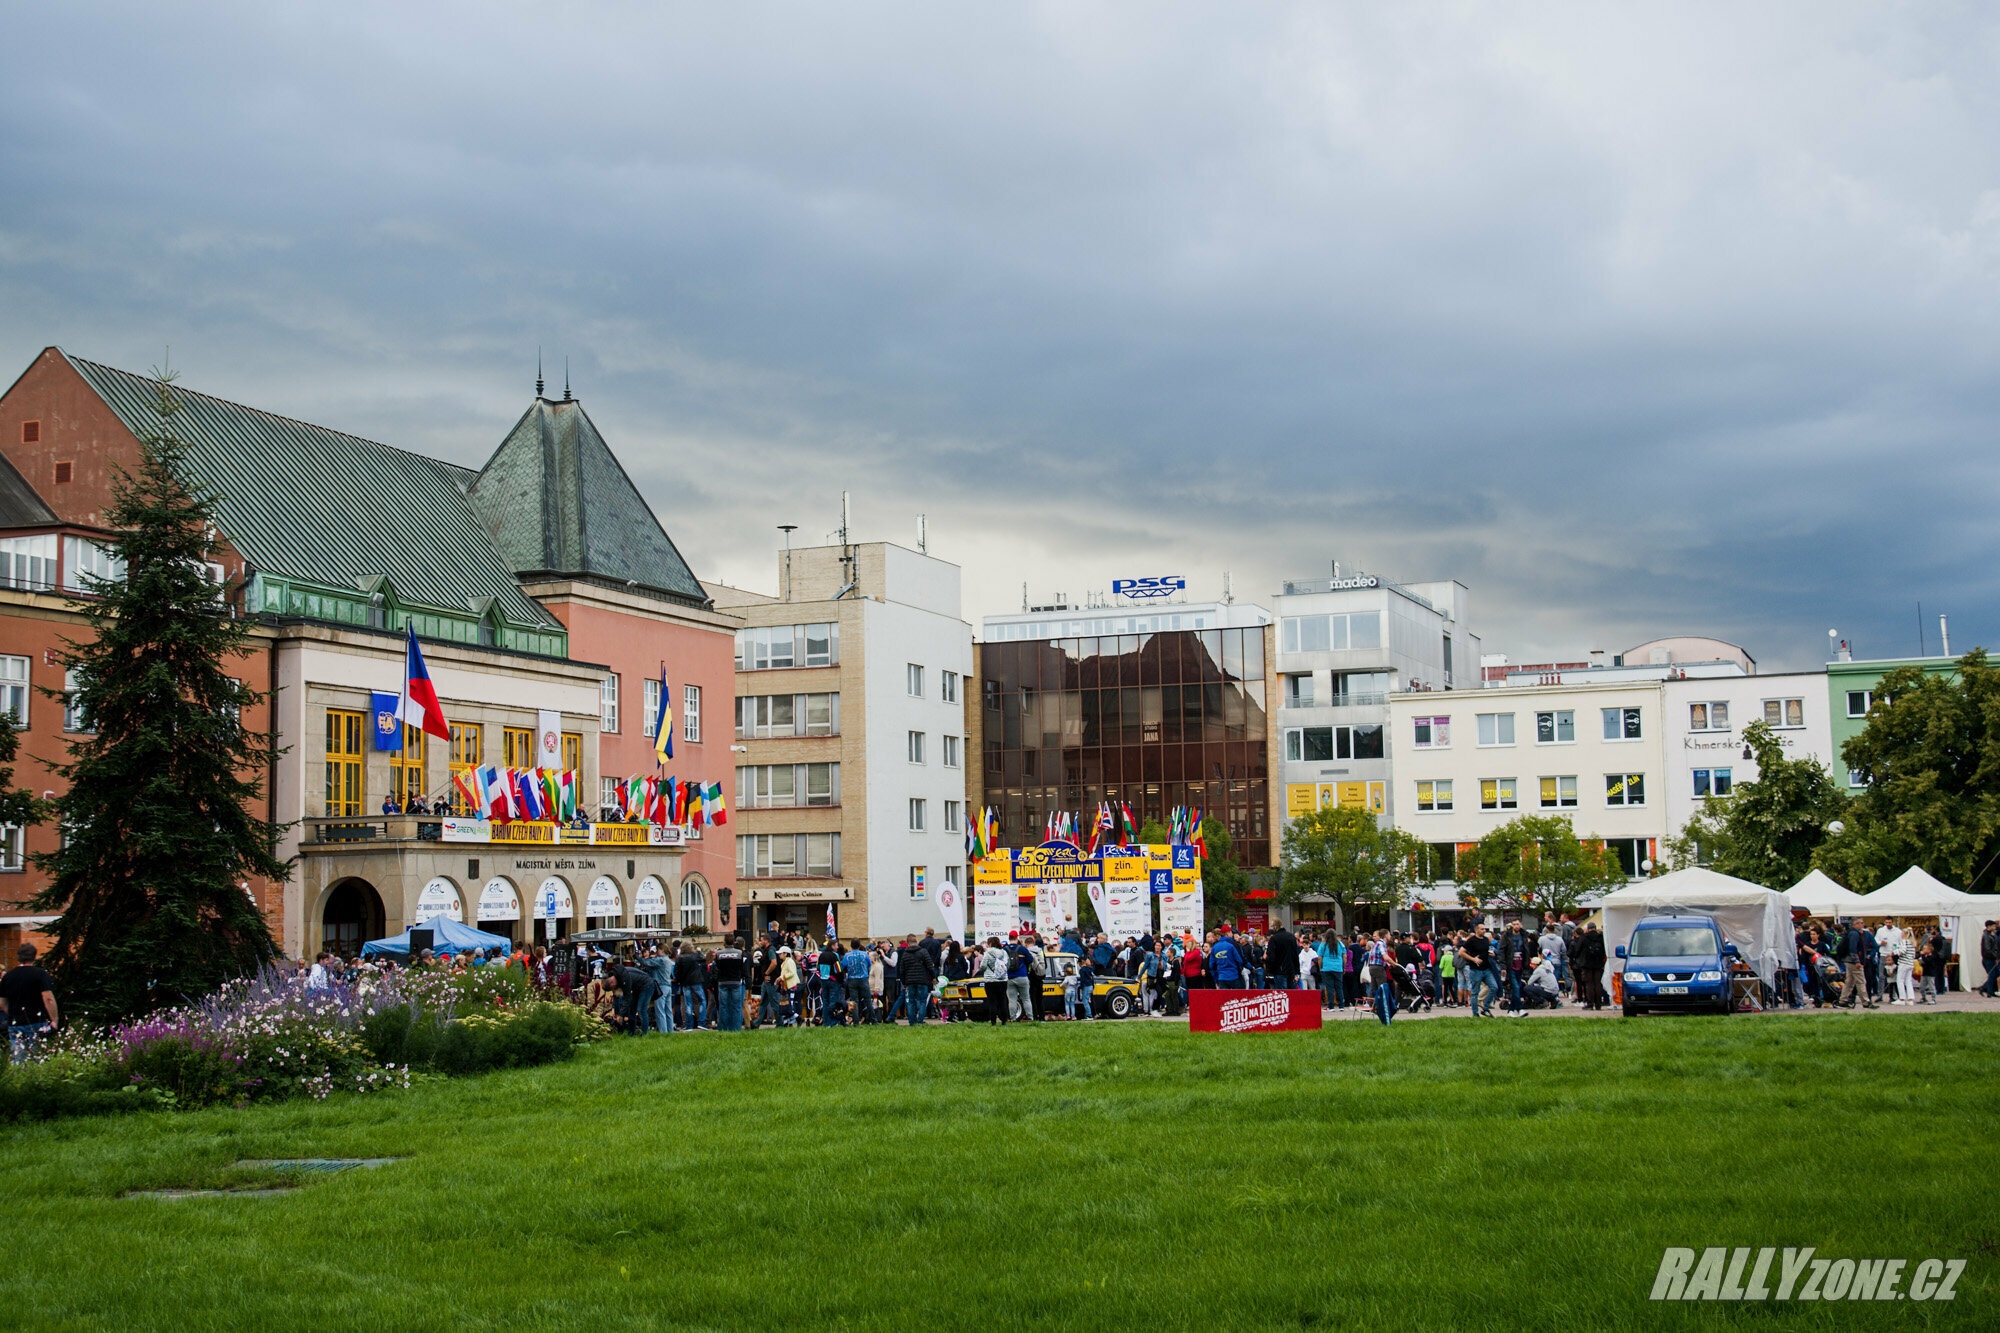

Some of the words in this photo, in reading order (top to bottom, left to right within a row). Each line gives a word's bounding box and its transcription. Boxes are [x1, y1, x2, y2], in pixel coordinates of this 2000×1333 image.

[1113, 576, 1185, 593] PSG
[1144, 732, 1159, 742] JANA
[516, 858, 551, 869] MAGISTRÁT
[554, 858, 575, 869] MĚSTA
[578, 858, 596, 869] ZLÍNA
[1015, 864, 1041, 879] BARUM
[1042, 864, 1063, 878] CZECH
[1064, 864, 1084, 878] RALLY
[1220, 1007, 1249, 1027] JEDU
[1249, 1007, 1259, 1018] NA
[1260, 998, 1289, 1018] DREN
